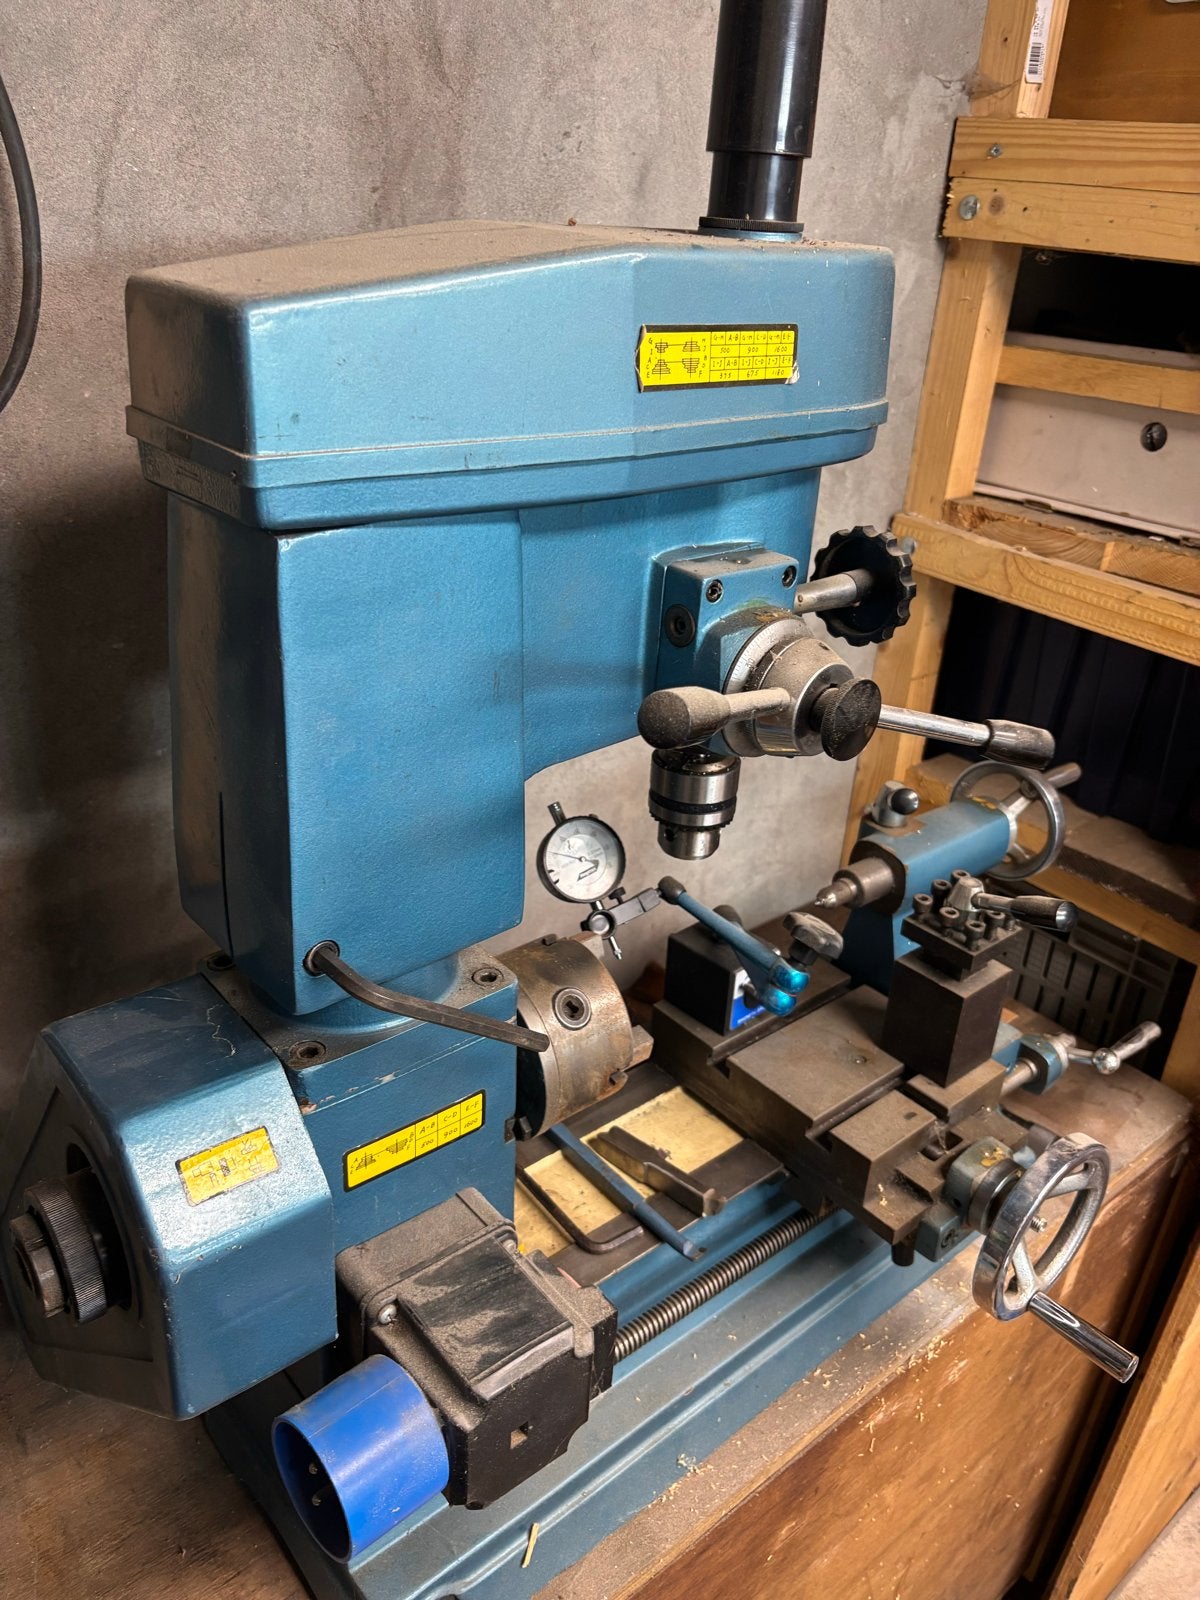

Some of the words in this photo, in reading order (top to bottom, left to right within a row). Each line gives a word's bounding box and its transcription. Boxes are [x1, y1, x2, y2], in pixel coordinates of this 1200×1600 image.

[747, 370, 759, 378] 675
[419, 1122, 435, 1134] A-B
[443, 1112, 458, 1122] C-D
[465, 1100, 479, 1111] E-F
[420, 1139, 434, 1148] 500
[443, 1128, 458, 1138] 900
[464, 1118, 478, 1128] 1600
